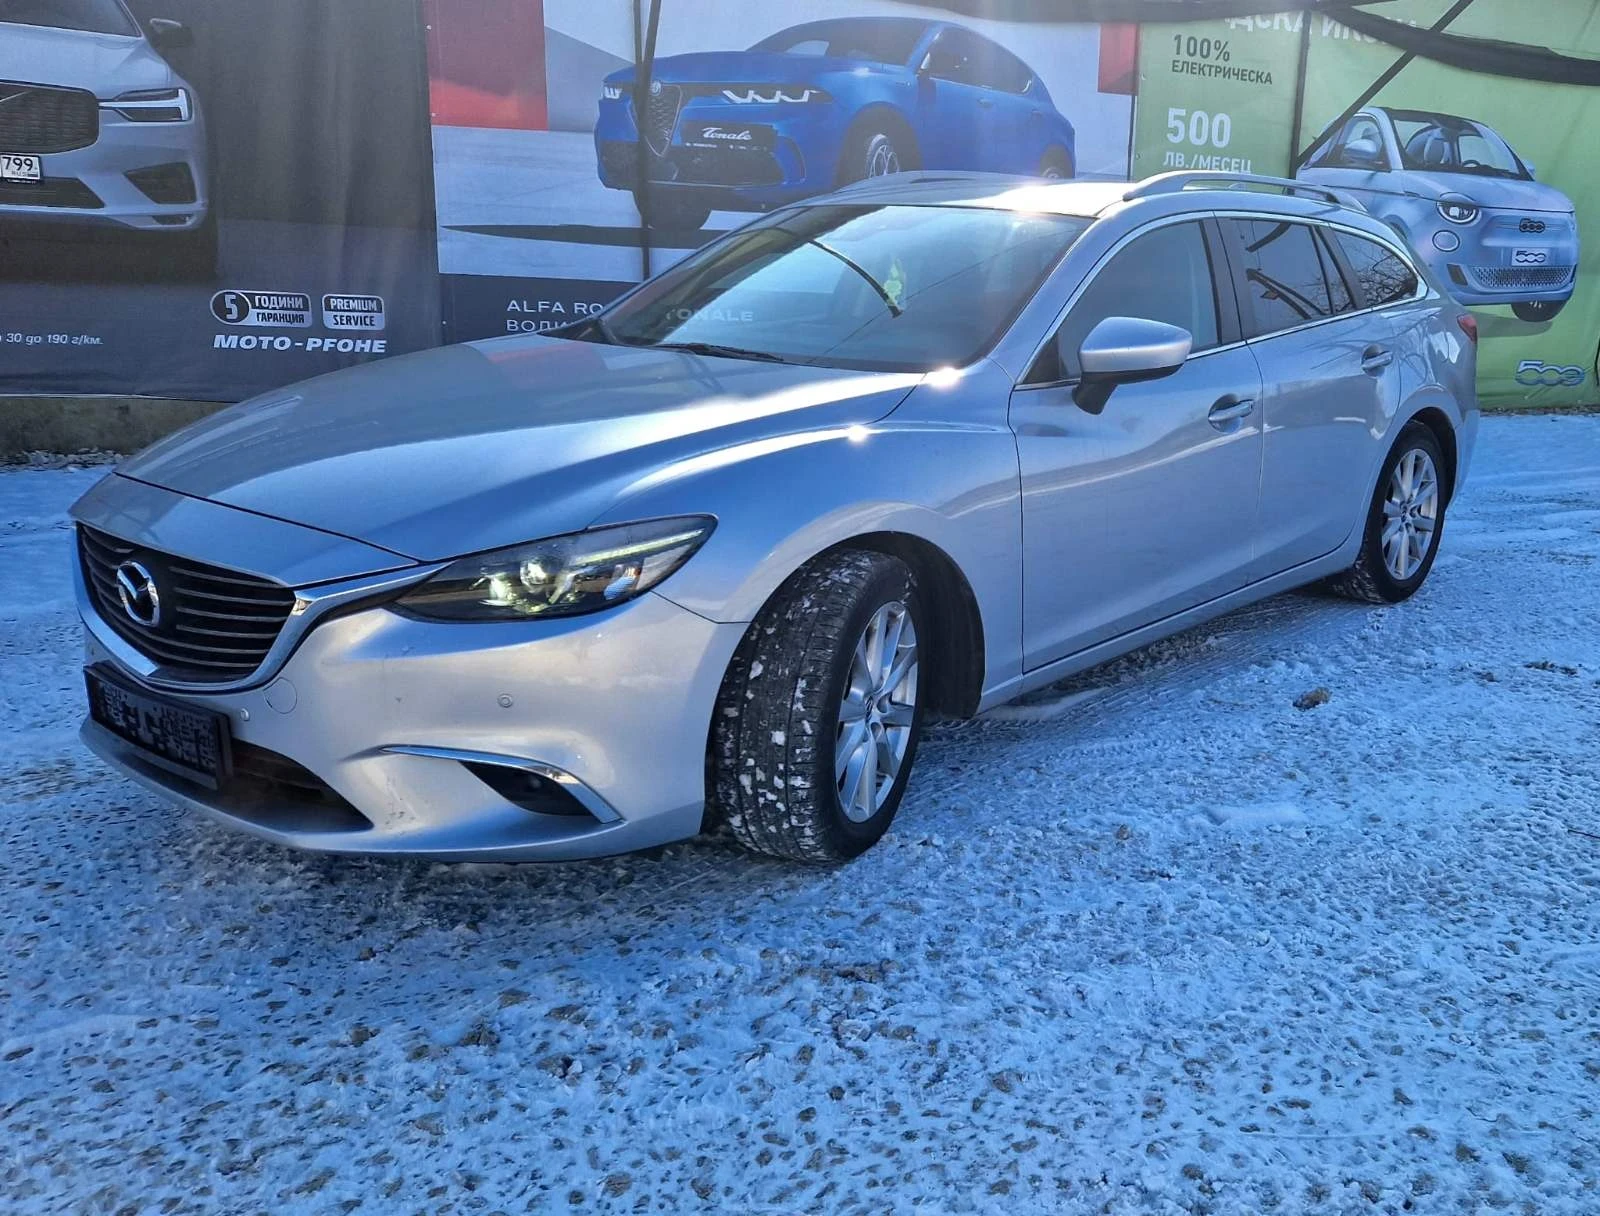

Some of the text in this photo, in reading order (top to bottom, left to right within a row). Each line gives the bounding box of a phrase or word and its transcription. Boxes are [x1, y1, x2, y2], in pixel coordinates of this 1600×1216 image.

[1173, 34, 1231, 62] 100%
[1171, 59, 1273, 85] ЕЛЕКТРИЧЕСКА
[702, 127, 752, 141] Tonale
[1166, 107, 1232, 149] 500
[2, 156, 34, 171] 799
[224, 294, 239, 320] 5
[255, 295, 304, 310] ГОДИНИ
[330, 298, 378, 312] PREMIUM
[507, 300, 566, 314] ALFA
[256, 311, 305, 325] ГАРАНЦИЯ
[333, 314, 376, 327] SERVICE
[6, 333, 22, 343] 30
[47, 334, 68, 344] 190
[1516, 360, 1585, 386] 500
